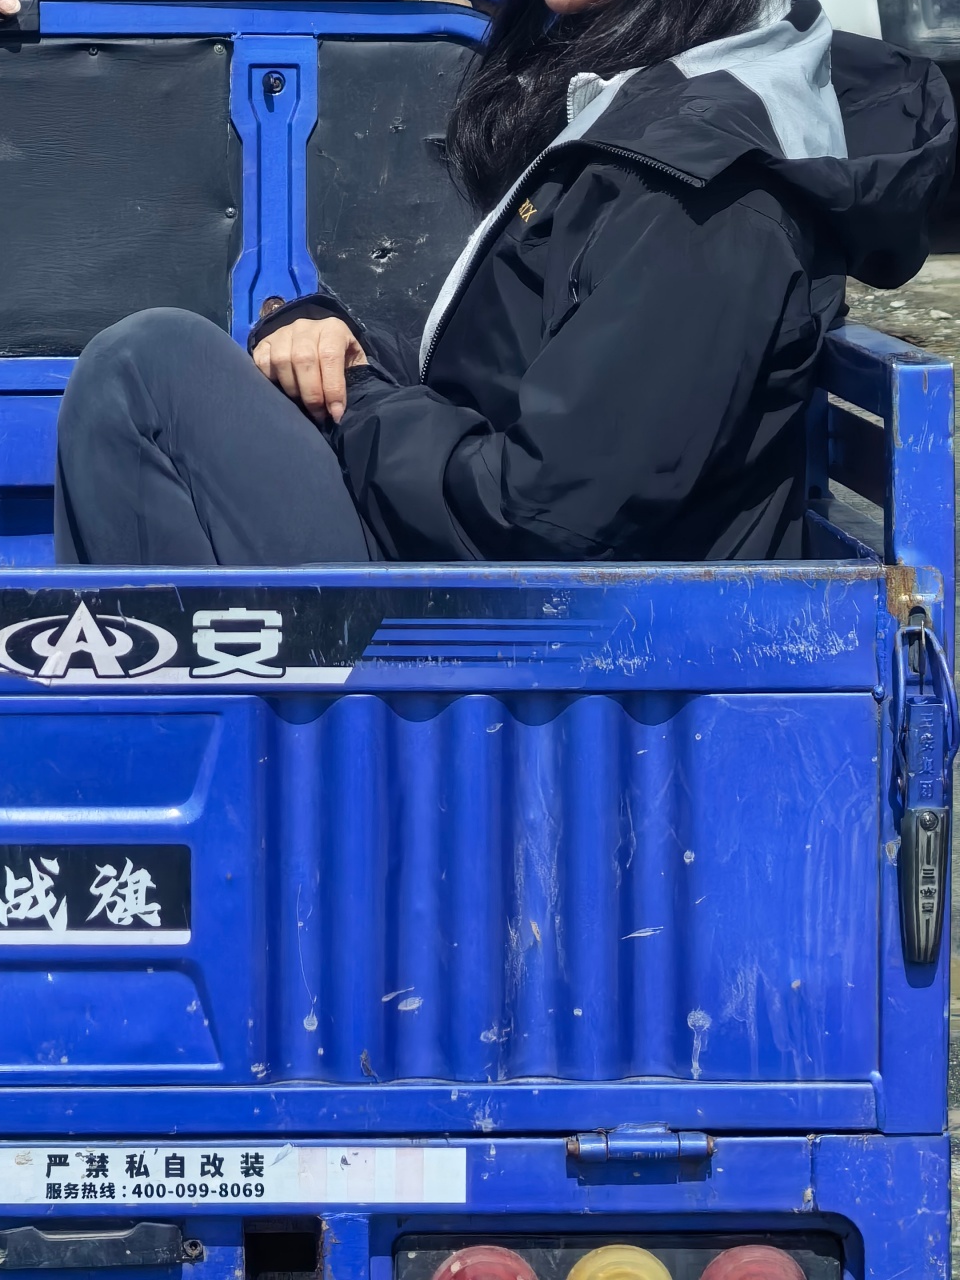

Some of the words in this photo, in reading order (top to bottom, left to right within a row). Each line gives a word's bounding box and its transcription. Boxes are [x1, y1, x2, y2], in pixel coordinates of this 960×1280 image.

[189, 607, 286, 679] 安
[46, 1152, 265, 1179] 严禁私自改装
